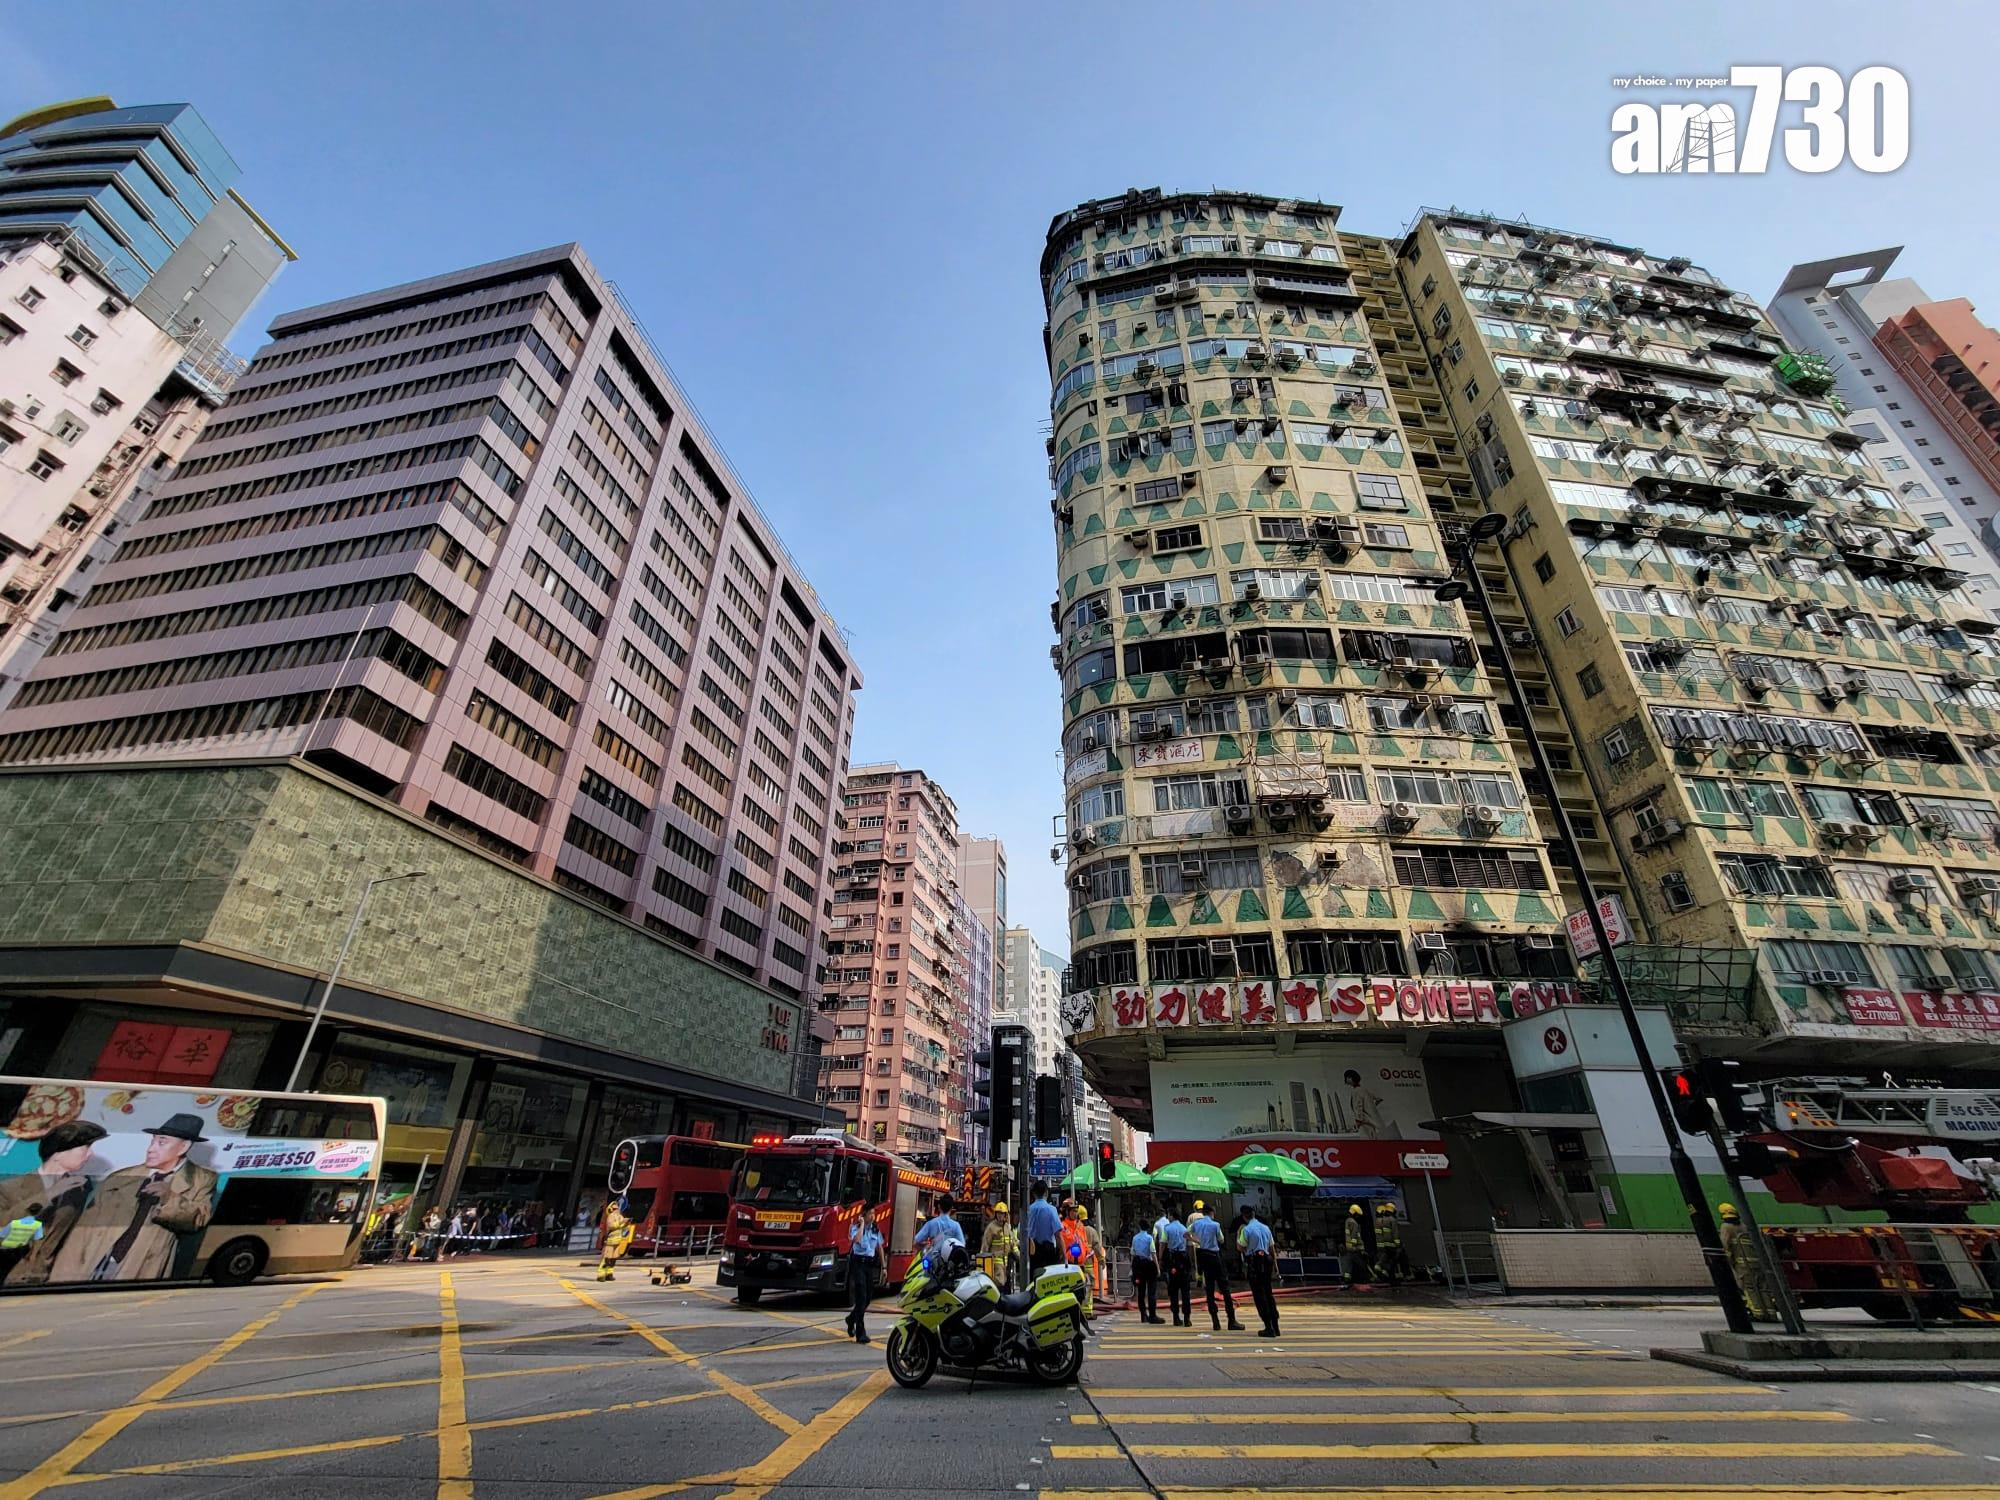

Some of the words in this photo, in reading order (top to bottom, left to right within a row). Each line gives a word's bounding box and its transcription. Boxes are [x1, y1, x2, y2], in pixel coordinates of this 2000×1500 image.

[1570, 901, 1613, 933] 蘇杭館
[1112, 981, 1366, 1026] 動力健美中心
[1372, 983, 1499, 1018] POWER
[768, 1003, 791, 1028] YUE
[761, 1027, 789, 1054] HWA
[1392, 1070, 1422, 1079] OCBC
